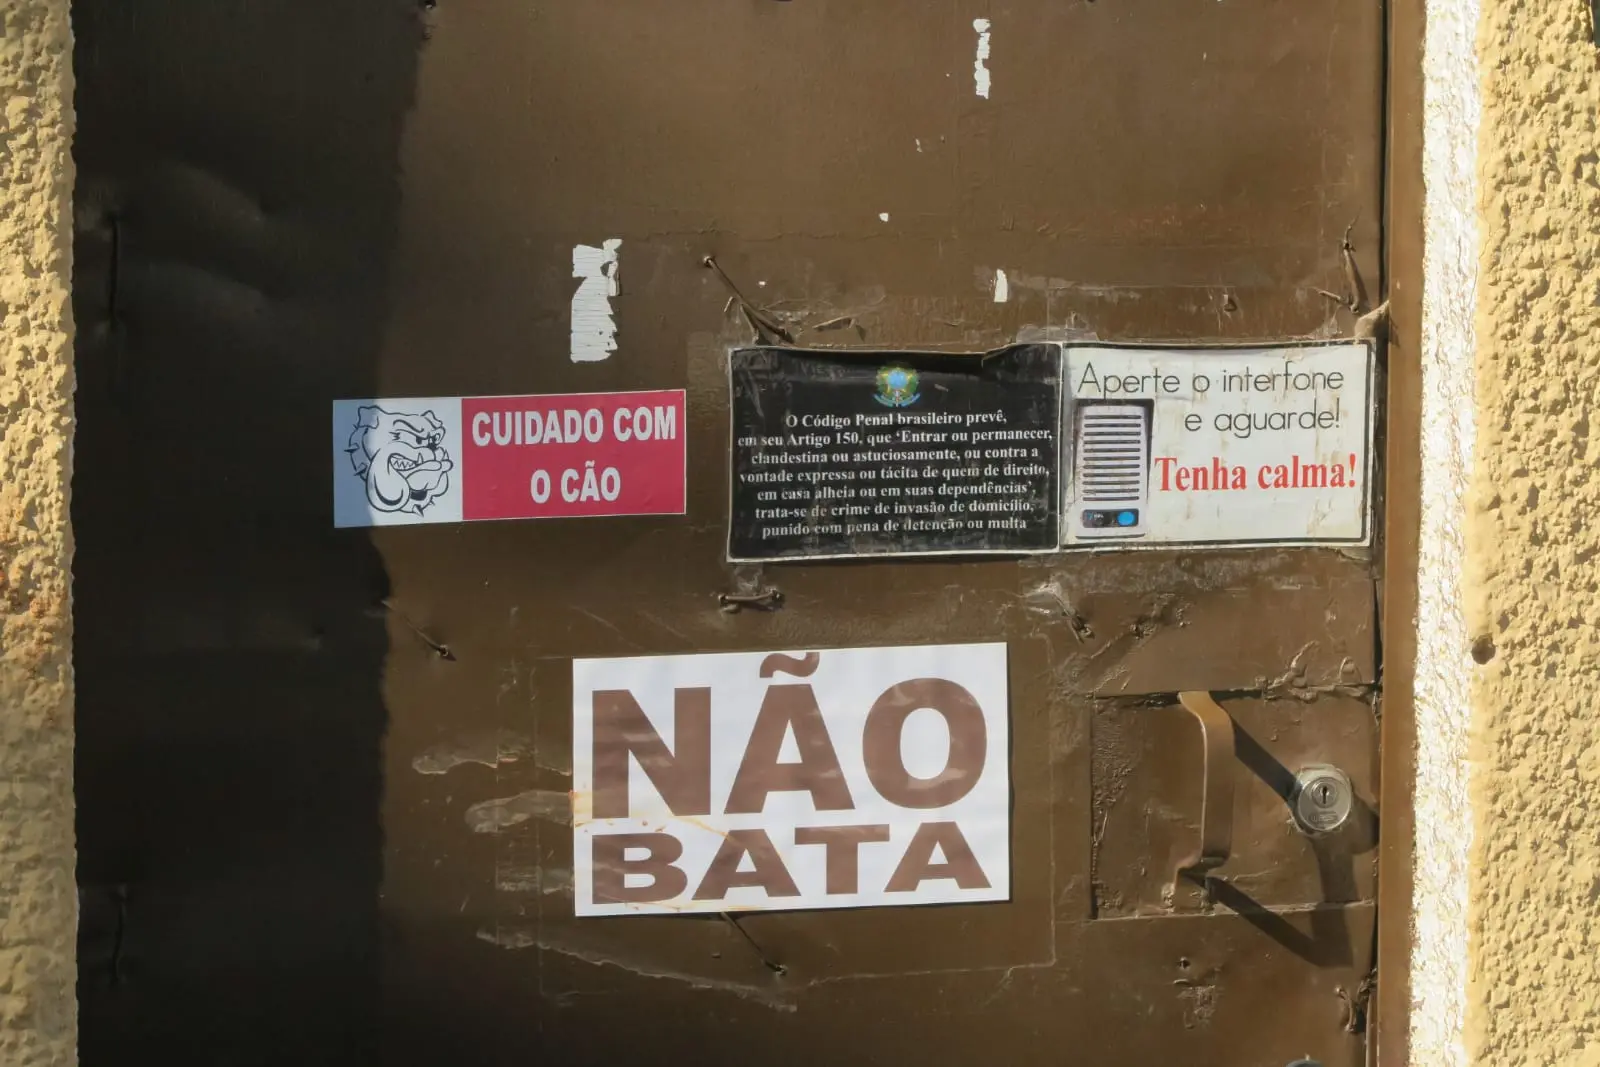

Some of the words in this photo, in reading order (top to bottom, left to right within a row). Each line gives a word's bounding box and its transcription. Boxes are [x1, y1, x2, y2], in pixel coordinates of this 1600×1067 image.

[1077, 362, 1180, 400] Aperte
[1192, 375, 1210, 393] o
[1223, 360, 1344, 392] interfone
[472, 408, 604, 446] CUIDADO
[614, 406, 676, 441] COM
[786, 415, 798, 427] O
[802, 414, 850, 430] Código
[856, 414, 893, 426] Penal
[898, 412, 962, 424] brasileiro
[966, 410, 1007, 426] prevê,
[1185, 414, 1202, 432] e
[1214, 398, 1340, 438] aguarde!
[738, 437, 757, 446] em
[762, 436, 783, 446] seu
[787, 433, 830, 448] Artigo
[867, 434, 892, 446] que
[952, 432, 968, 441] ou
[972, 430, 1052, 444] permanecer,
[752, 452, 828, 464] clandestina
[832, 454, 848, 462] ou
[854, 449, 960, 462] astuciosamente,
[964, 449, 980, 458] ou
[985, 448, 1027, 458] contra
[1032, 448, 1038, 457] a
[531, 469, 550, 504] O
[561, 460, 621, 502] CÃO
[740, 470, 793, 482] vontade
[798, 470, 855, 484] expressa
[860, 470, 876, 479] ou
[880, 466, 918, 479] tácita
[922, 466, 938, 478] de
[942, 467, 980, 480] quem
[984, 464, 1000, 476] de
[1004, 464, 1050, 476] direito,
[1154, 456, 1247, 492] Tenha
[1258, 454, 1356, 489] calma!
[758, 491, 776, 500] em
[782, 489, 810, 499] casa
[815, 485, 855, 499] alheia
[860, 488, 876, 498] ou
[880, 487, 900, 496] em
[905, 486, 934, 496] suas
[756, 505, 807, 518] trata-se
[811, 505, 826, 517] de
[832, 504, 870, 516] crime
[874, 503, 890, 514] de
[894, 502, 945, 514] invasão
[949, 500, 965, 512] de
[969, 500, 1034, 512] domicílio,
[762, 524, 810, 540] punido
[814, 523, 842, 534] com
[846, 522, 878, 534] pena
[884, 520, 899, 531] de
[904, 518, 963, 532] detenção
[968, 520, 983, 528] ou
[988, 518, 1027, 528] multa
[592, 652, 987, 819] NÃO
[592, 821, 992, 904] BATA
